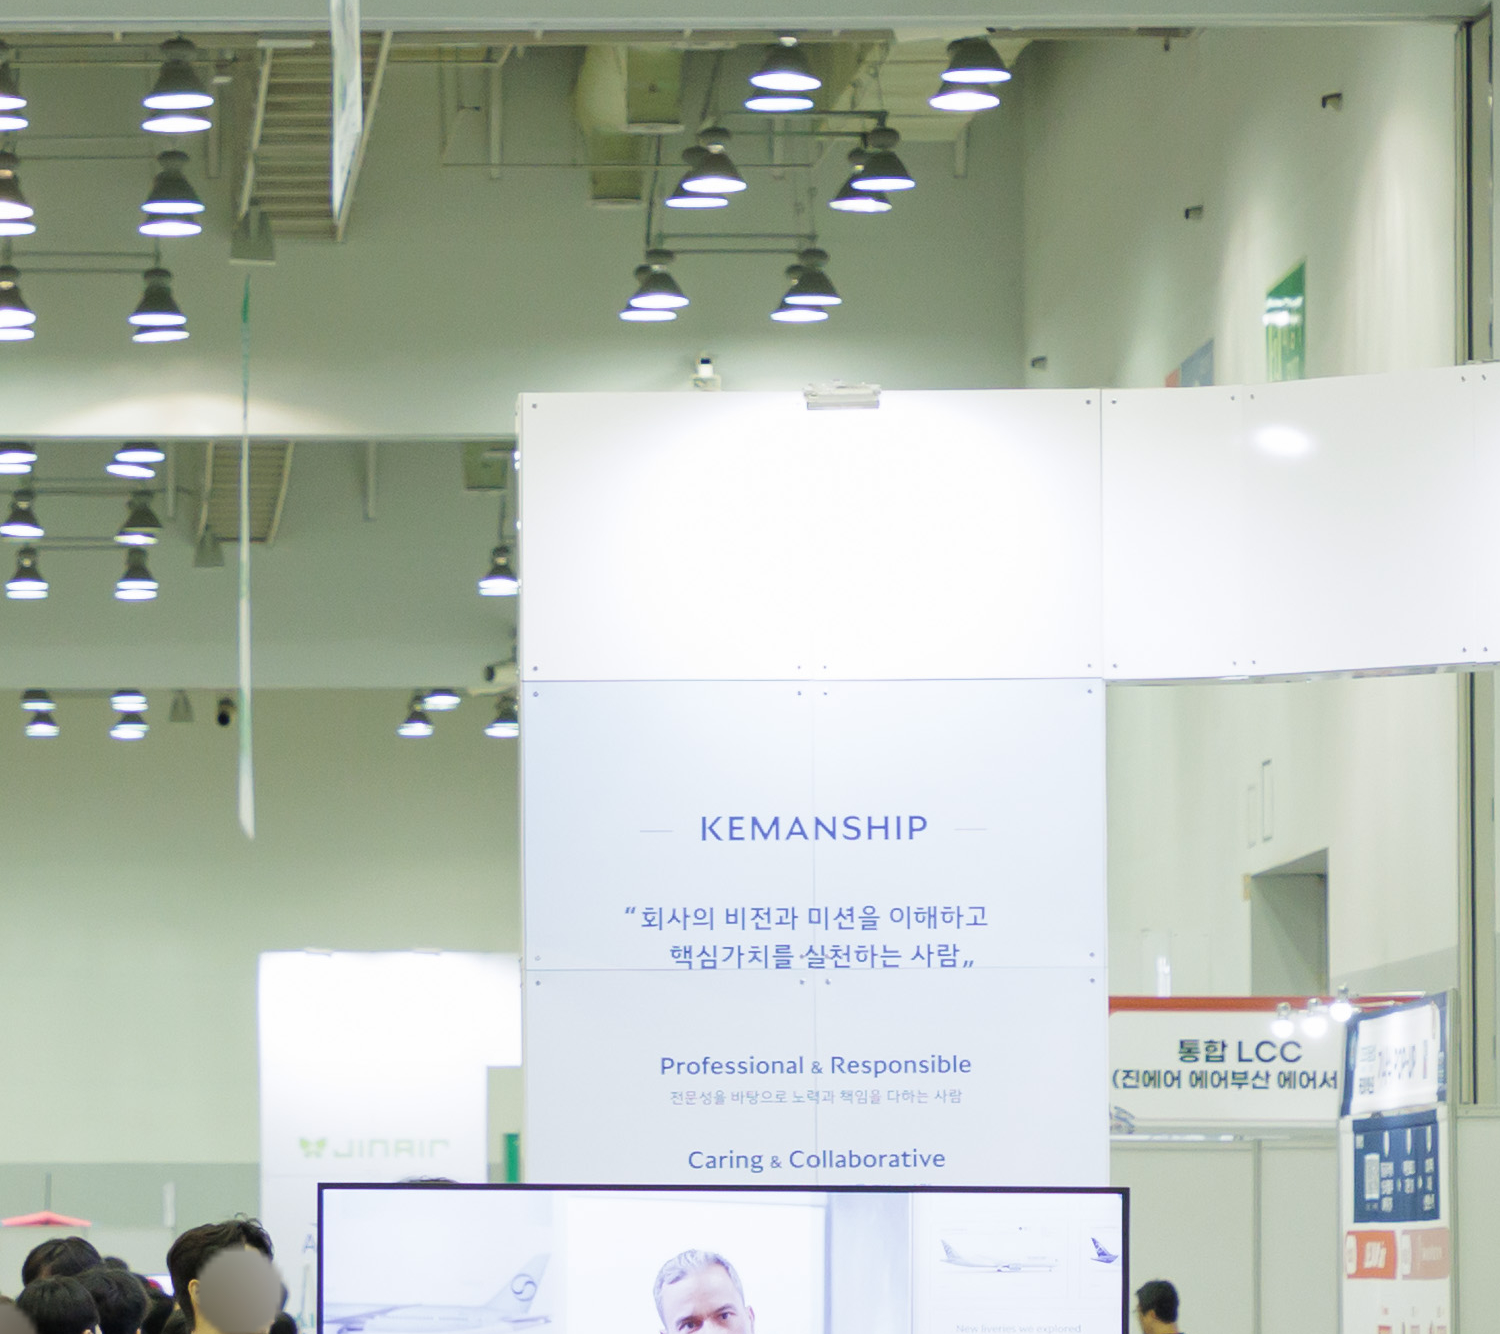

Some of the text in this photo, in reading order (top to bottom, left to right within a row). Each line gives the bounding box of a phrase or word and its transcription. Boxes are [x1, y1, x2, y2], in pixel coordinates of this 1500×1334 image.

[701, 816, 928, 841] KEMANSHIP
[724, 906, 798, 931] 비전과
[808, 905, 880, 931] 미션을
[890, 906, 989, 930] 이해하고
[670, 944, 795, 970] 핵심가치를
[804, 944, 902, 970] 실천하는
[1178, 1039, 1303, 1063] 통합 LCC
[660, 1055, 972, 1078] Professional & Responsible
[1112, 1069, 1182, 1090] (진에어
[1188, 1069, 1271, 1090] 에어부산
[731, 1089, 786, 1106] 바탕으로
[887, 1089, 929, 1105] 다하는
[934, 1089, 962, 1105] 사람
[688, 1149, 945, 1174] Caring & Collaborative
[956, 1323, 1082, 1334] New liveries we explored
